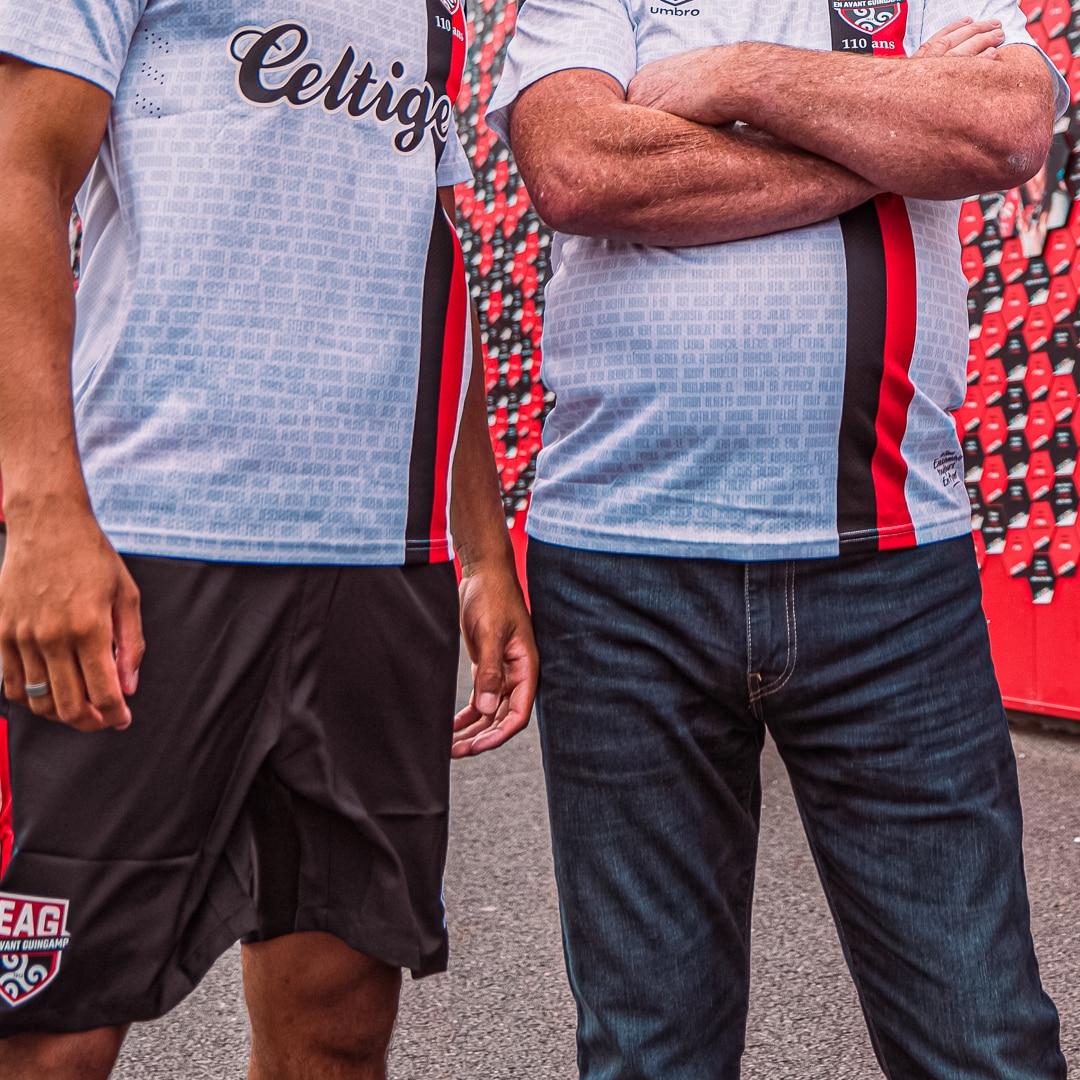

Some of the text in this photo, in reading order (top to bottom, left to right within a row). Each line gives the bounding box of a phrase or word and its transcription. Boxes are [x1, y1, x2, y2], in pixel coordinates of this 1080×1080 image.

[650, 6, 700, 17] umbro
[435, 15, 464, 41] 110 ans
[842, 38, 895, 49] 110 ans
[227, 20, 452, 153] Celtige
[0, 900, 61, 937] EAG
[0, 938, 69, 951] VANT GUINGAMP
